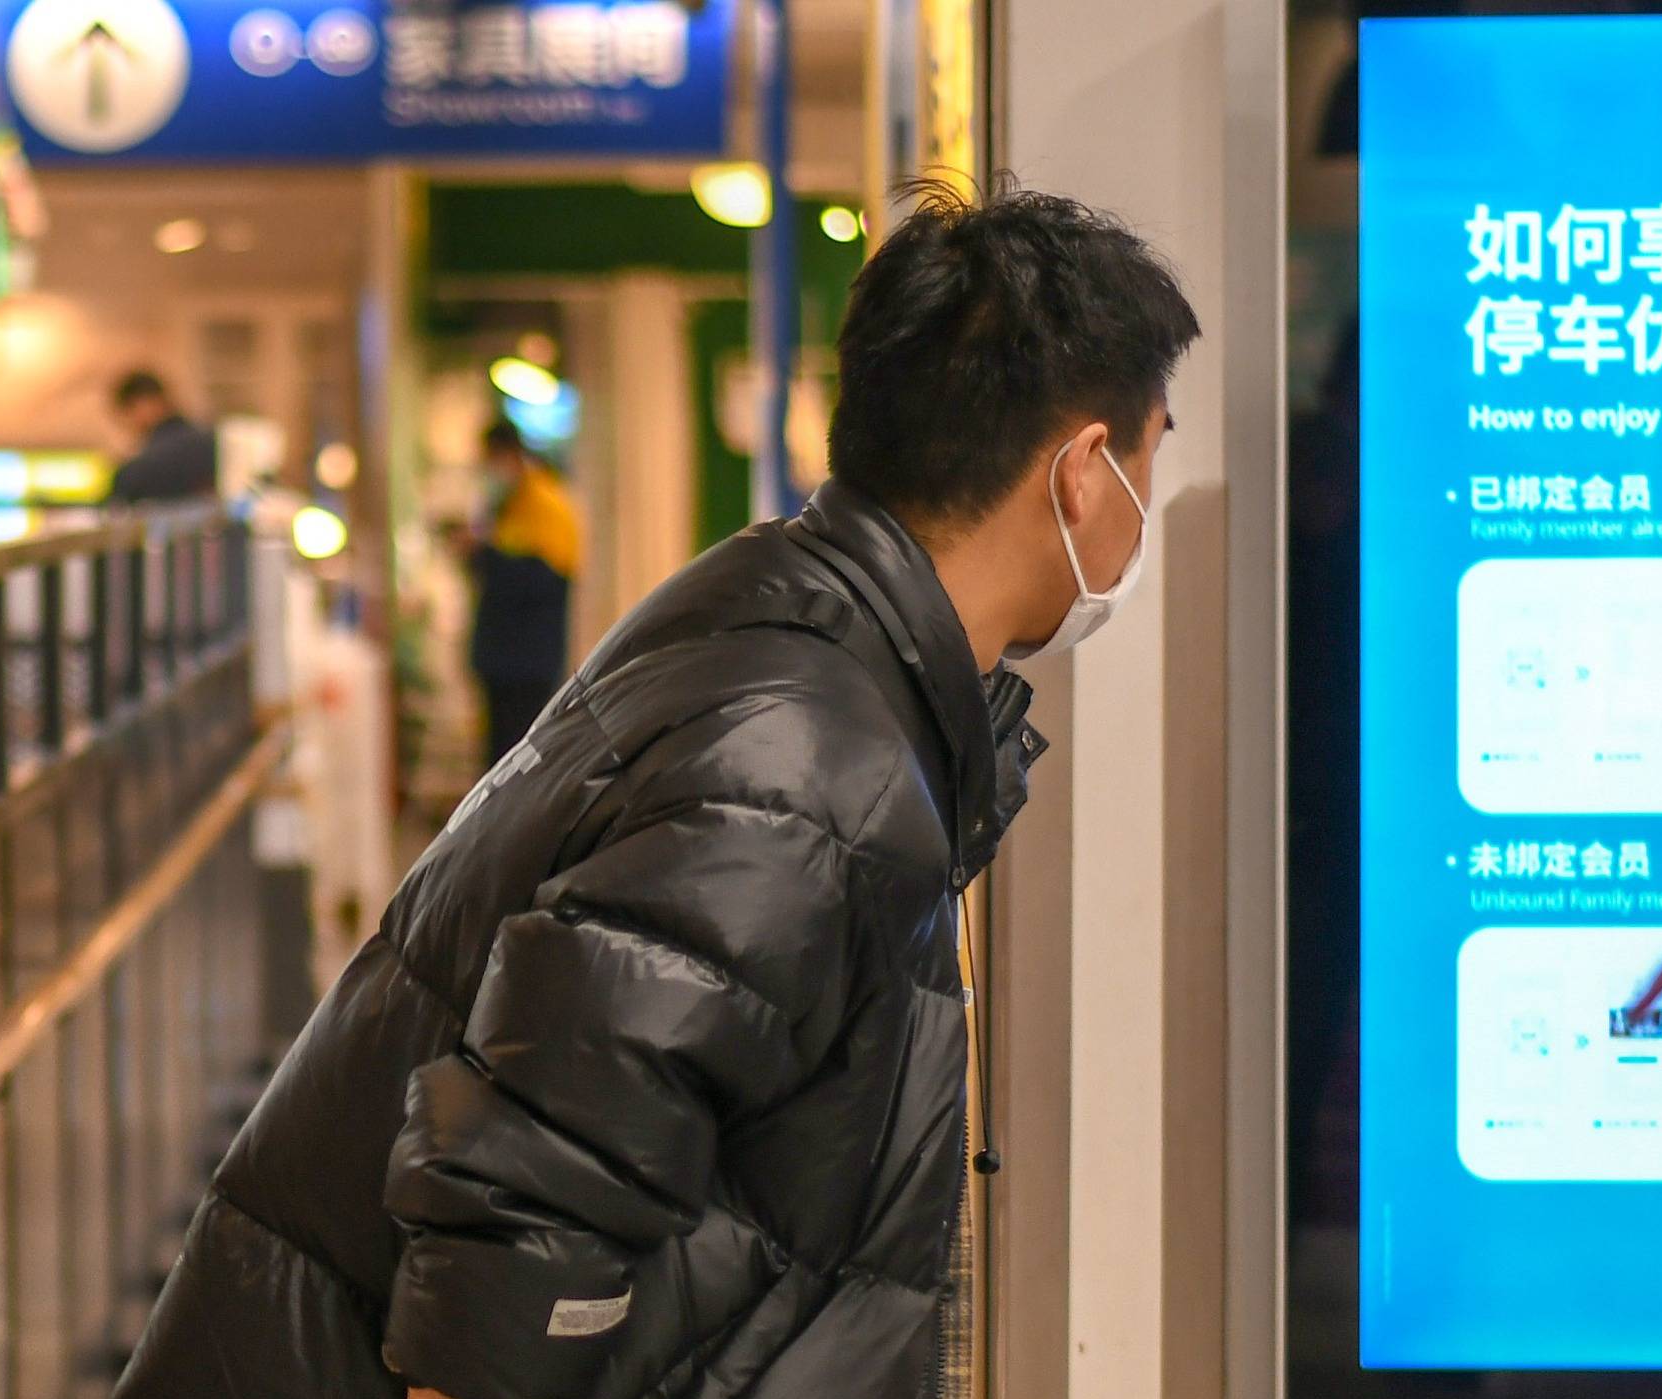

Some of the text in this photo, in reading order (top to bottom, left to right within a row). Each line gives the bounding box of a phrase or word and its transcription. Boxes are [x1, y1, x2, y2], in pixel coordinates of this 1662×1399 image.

[1468, 404, 1535, 430] How
[1542, 405, 1574, 431] to
[1580, 401, 1661, 438] enjoy
[1469, 474, 1652, 512] 已绑定会员
[1540, 517, 1624, 540] member
[1469, 841, 1651, 880] 未绑定会员
[1470, 889, 1565, 912] Unbound
